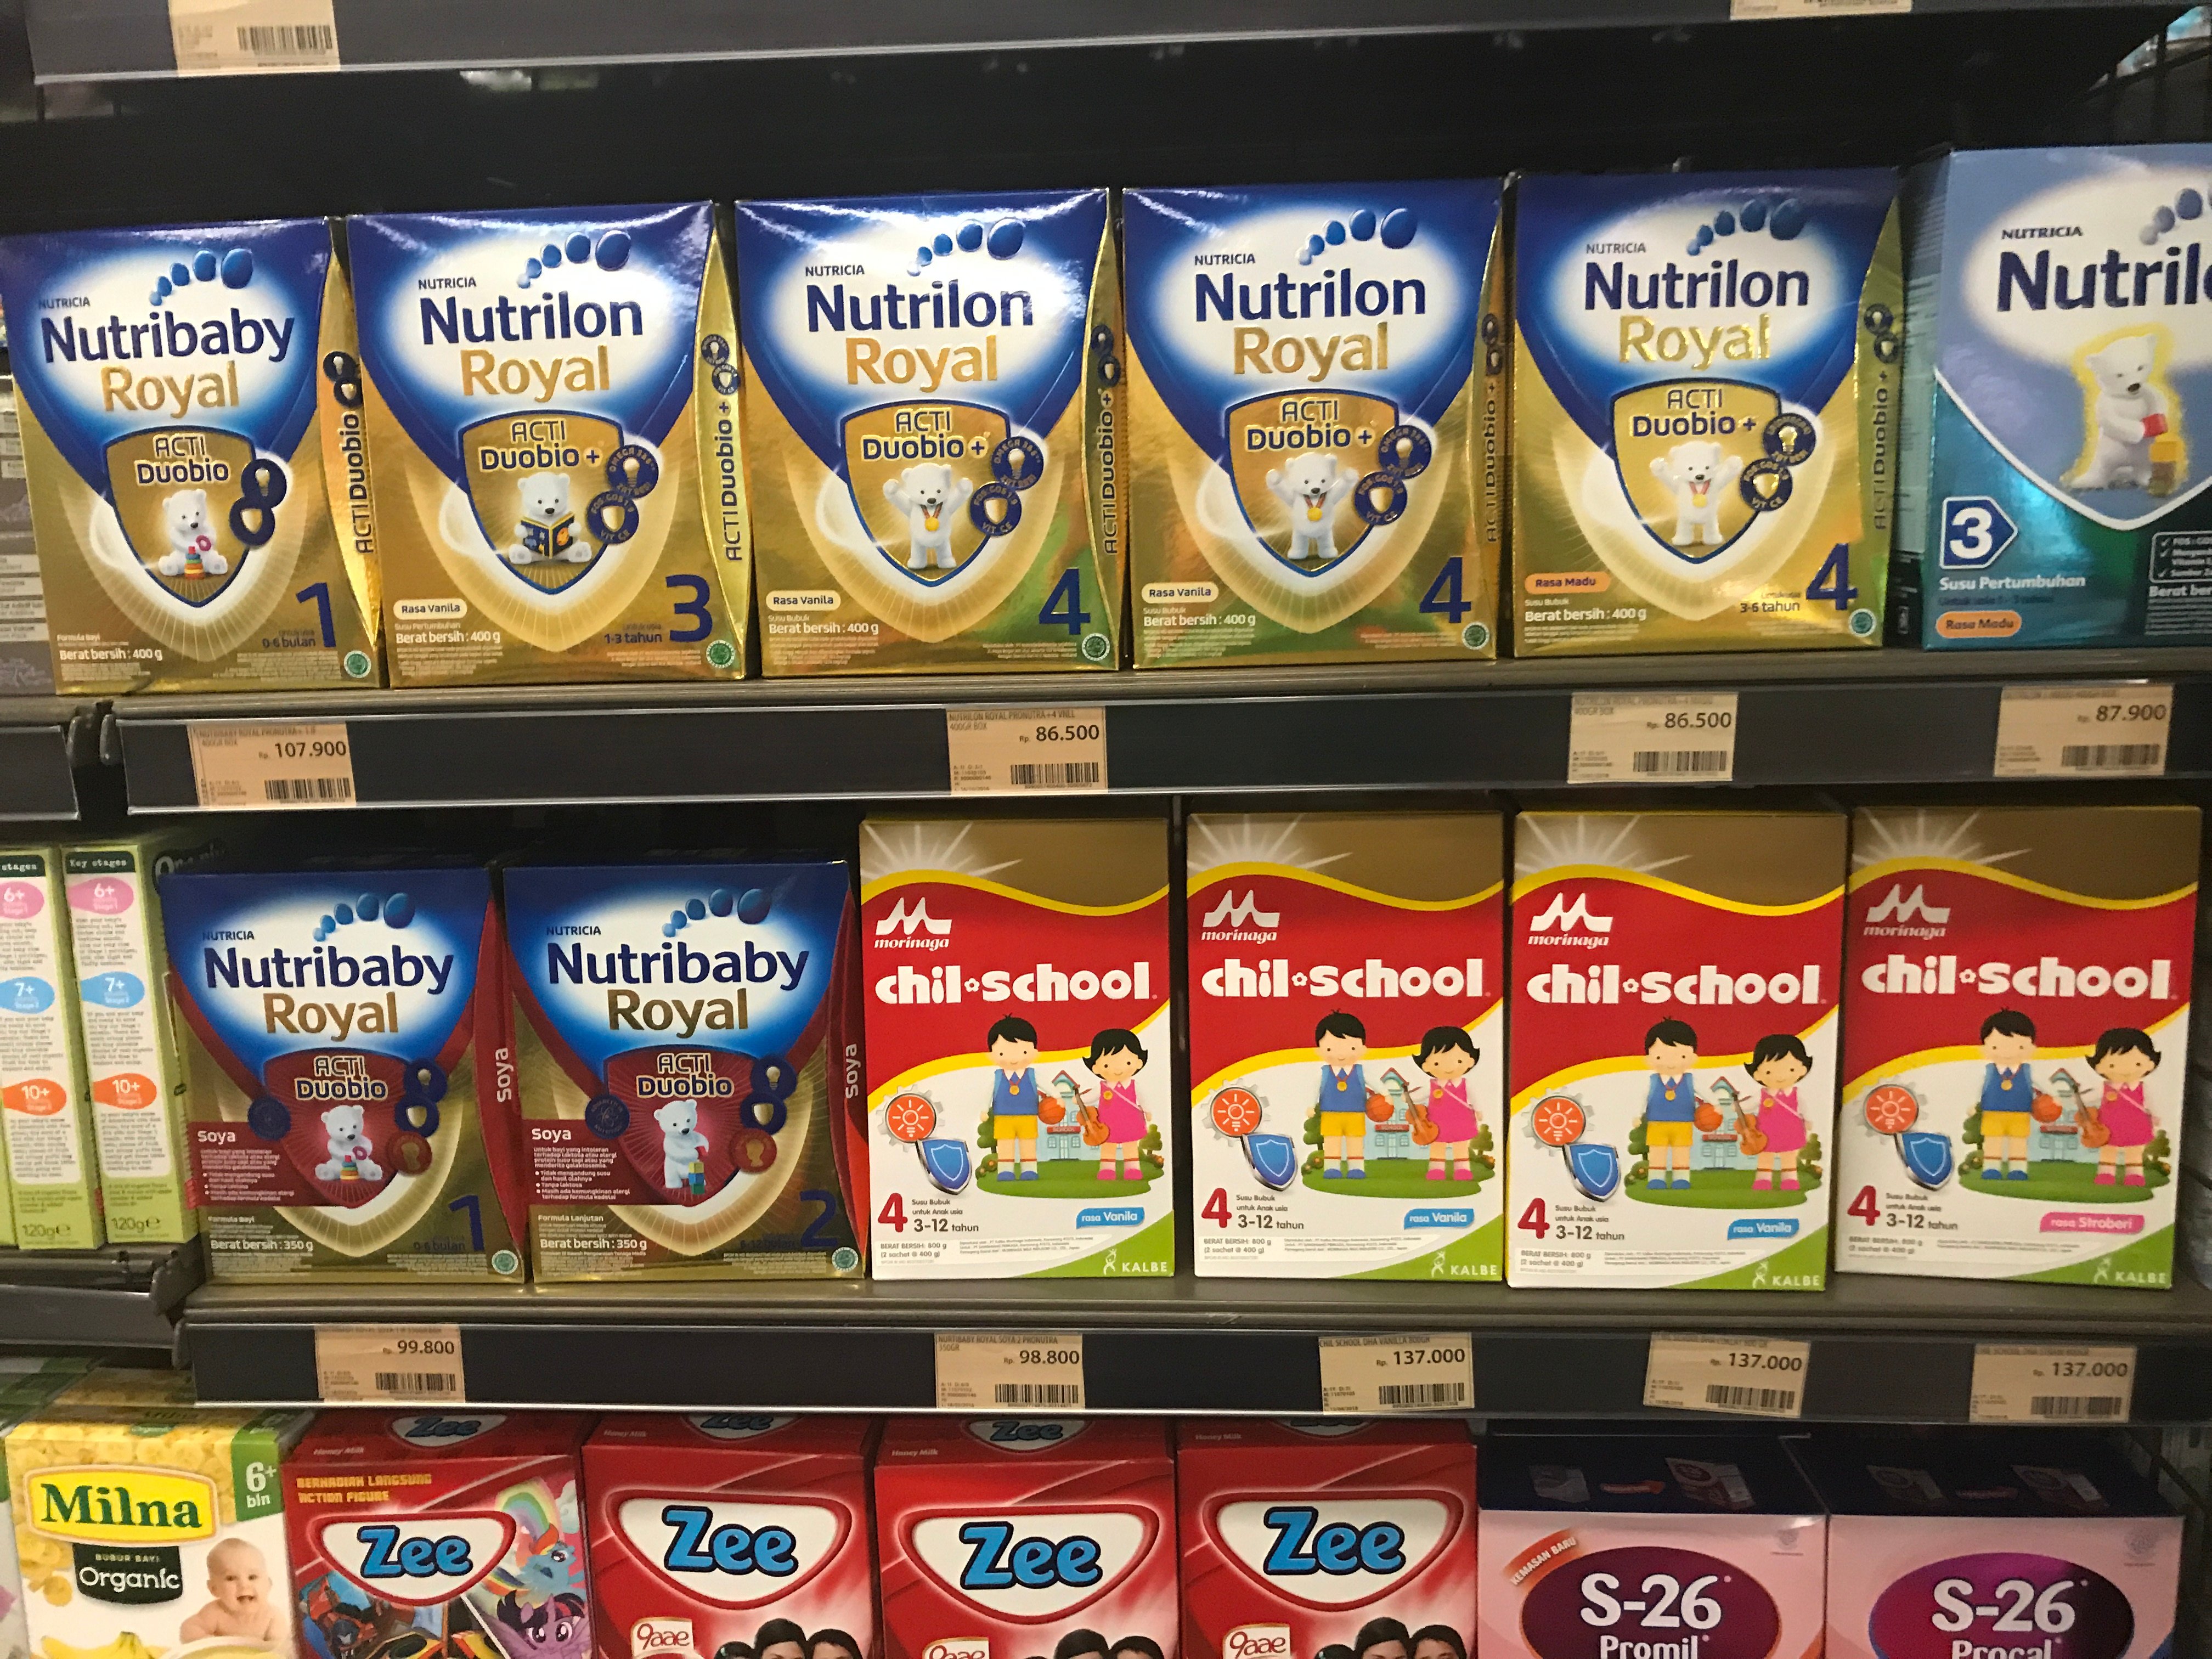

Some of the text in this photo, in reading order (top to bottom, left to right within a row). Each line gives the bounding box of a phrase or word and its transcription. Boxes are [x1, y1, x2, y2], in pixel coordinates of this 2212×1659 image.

[2002, 226, 2083, 240] NUTRICIA
[1586, 241, 1646, 254] NUTRICIA
[1195, 253, 1255, 265] NUTRICIA
[805, 264, 864, 276] NUTRICIA
[418, 277, 476, 290] NUTRICIA
[1585, 259, 1808, 311] Nutrilon
[39, 297, 90, 310] NUTRICIA
[1195, 268, 1426, 322] Nutrilon
[807, 279, 1033, 332] Nutrilon
[420, 291, 643, 345] Nutrilon
[41, 308, 294, 363] Nutribaby
[1619, 313, 1769, 370] Royal
[1233, 321, 1387, 382] Royal
[845, 335, 997, 393] Royal
[461, 345, 610, 403] Royal
[100, 360, 239, 419] Royal
[1668, 389, 1723, 409] ACTI
[1282, 401, 1338, 421] ACTI
[896, 411, 951, 432] ACTI
[512, 421, 565, 442] ACTI
[155, 437, 205, 456] ACTI
[137, 459, 228, 484] Duobio
[1949, 507, 1993, 558] 3
[1536, 576, 1595, 588] Rasa Madu
[1805, 543, 1858, 611] 4
[1939, 574, 2086, 590] Susu Pertumbuhan
[1149, 586, 1211, 597] Rasa Vanila
[1419, 556, 1472, 623] 4
[402, 602, 460, 614] Rasa Vanila
[665, 574, 713, 642] 3
[773, 594, 833, 605] Rasa Vanila
[1039, 568, 1091, 635] 4
[1740, 600, 1800, 613] 3-6 tahun
[296, 582, 336, 647] 1
[1946, 618, 2014, 630] Rasa Madu
[396, 631, 427, 644] Berat
[470, 631, 489, 642] 400
[491, 633, 500, 644] g
[605, 632, 662, 644] 1-3 tahun
[1664, 712, 1731, 728] 86.500
[2096, 704, 2166, 721] 87.900
[1036, 725, 1099, 741] 86.500
[275, 741, 346, 758] 107.900
[70, 859, 127, 868] Key stages
[94, 883, 115, 898] 6+
[202, 930, 255, 941] NUTRICIA
[546, 925, 601, 936] NUTRICIA
[1201, 929, 1277, 944] morinaga
[1864, 926, 1946, 940] morinaga
[874, 936, 949, 951] morinaga
[1528, 934, 1609, 949] morinaga
[204, 945, 454, 995] Nutribaby
[548, 941, 809, 991] Nutribaby
[105, 978, 125, 992] 7+
[263, 991, 398, 1042] Royal
[607, 988, 748, 1039] Royal
[315, 1057, 364, 1076] ACTI
[659, 1054, 710, 1073] ACTI
[845, 1044, 861, 1098] Soya
[496, 1048, 514, 1102] Soya
[22, 1085, 50, 1099] 10+
[112, 1080, 140, 1093] 10+
[297, 1079, 386, 1099] Duobio
[639, 1075, 732, 1096] Duobio
[198, 1130, 235, 1144] Soya
[532, 1128, 571, 1143] Soya
[878, 1193, 908, 1233] 4
[1201, 1187, 1232, 1228] 4
[1847, 1185, 1881, 1226] 4
[448, 1194, 484, 1251] 1
[799, 1189, 838, 1247] 2
[1081, 1210, 1137, 1222] rasa Vanila
[1238, 1214, 1304, 1229] 3-12 tahun
[1409, 1212, 1466, 1223] rasa Vanila
[1517, 1198, 1550, 1239] 4
[2078, 1217, 2132, 1229] Stroberi
[913, 1218, 979, 1233] 3-12 tahun
[1122, 1261, 1167, 1273] KALBE
[1451, 1265, 1497, 1276] KALBE
[1773, 1274, 1819, 1286] KALBE
[2115, 1271, 2166, 1284] KALBE
[397, 1340, 455, 1354] 99.800
[1019, 1350, 1080, 1364] 98.800
[1393, 1348, 1465, 1365] 137.000
[1729, 1352, 1802, 1371] 137.000
[2052, 1362, 2128, 1377] 137.000
[990, 1421, 1064, 1441] Zee
[368, 1474, 432, 1487] LANGSUNG
[41, 1483, 202, 1529] Milna
[247, 1494, 270, 1508] bln
[298, 1490, 389, 1504] ACTION FIGURE
[662, 1505, 799, 1577] Zee
[1263, 1506, 1405, 1576] Zee
[95, 1553, 132, 1562] BUBUR
[357, 1525, 473, 1578] Zee
[959, 1521, 1103, 1590] Zee
[1510, 1537, 1577, 1585] KEMASAN BARU
[79, 1566, 180, 1593] Organic
[1581, 1573, 1722, 1629] S-26
[1932, 1579, 2075, 1633] S-26
